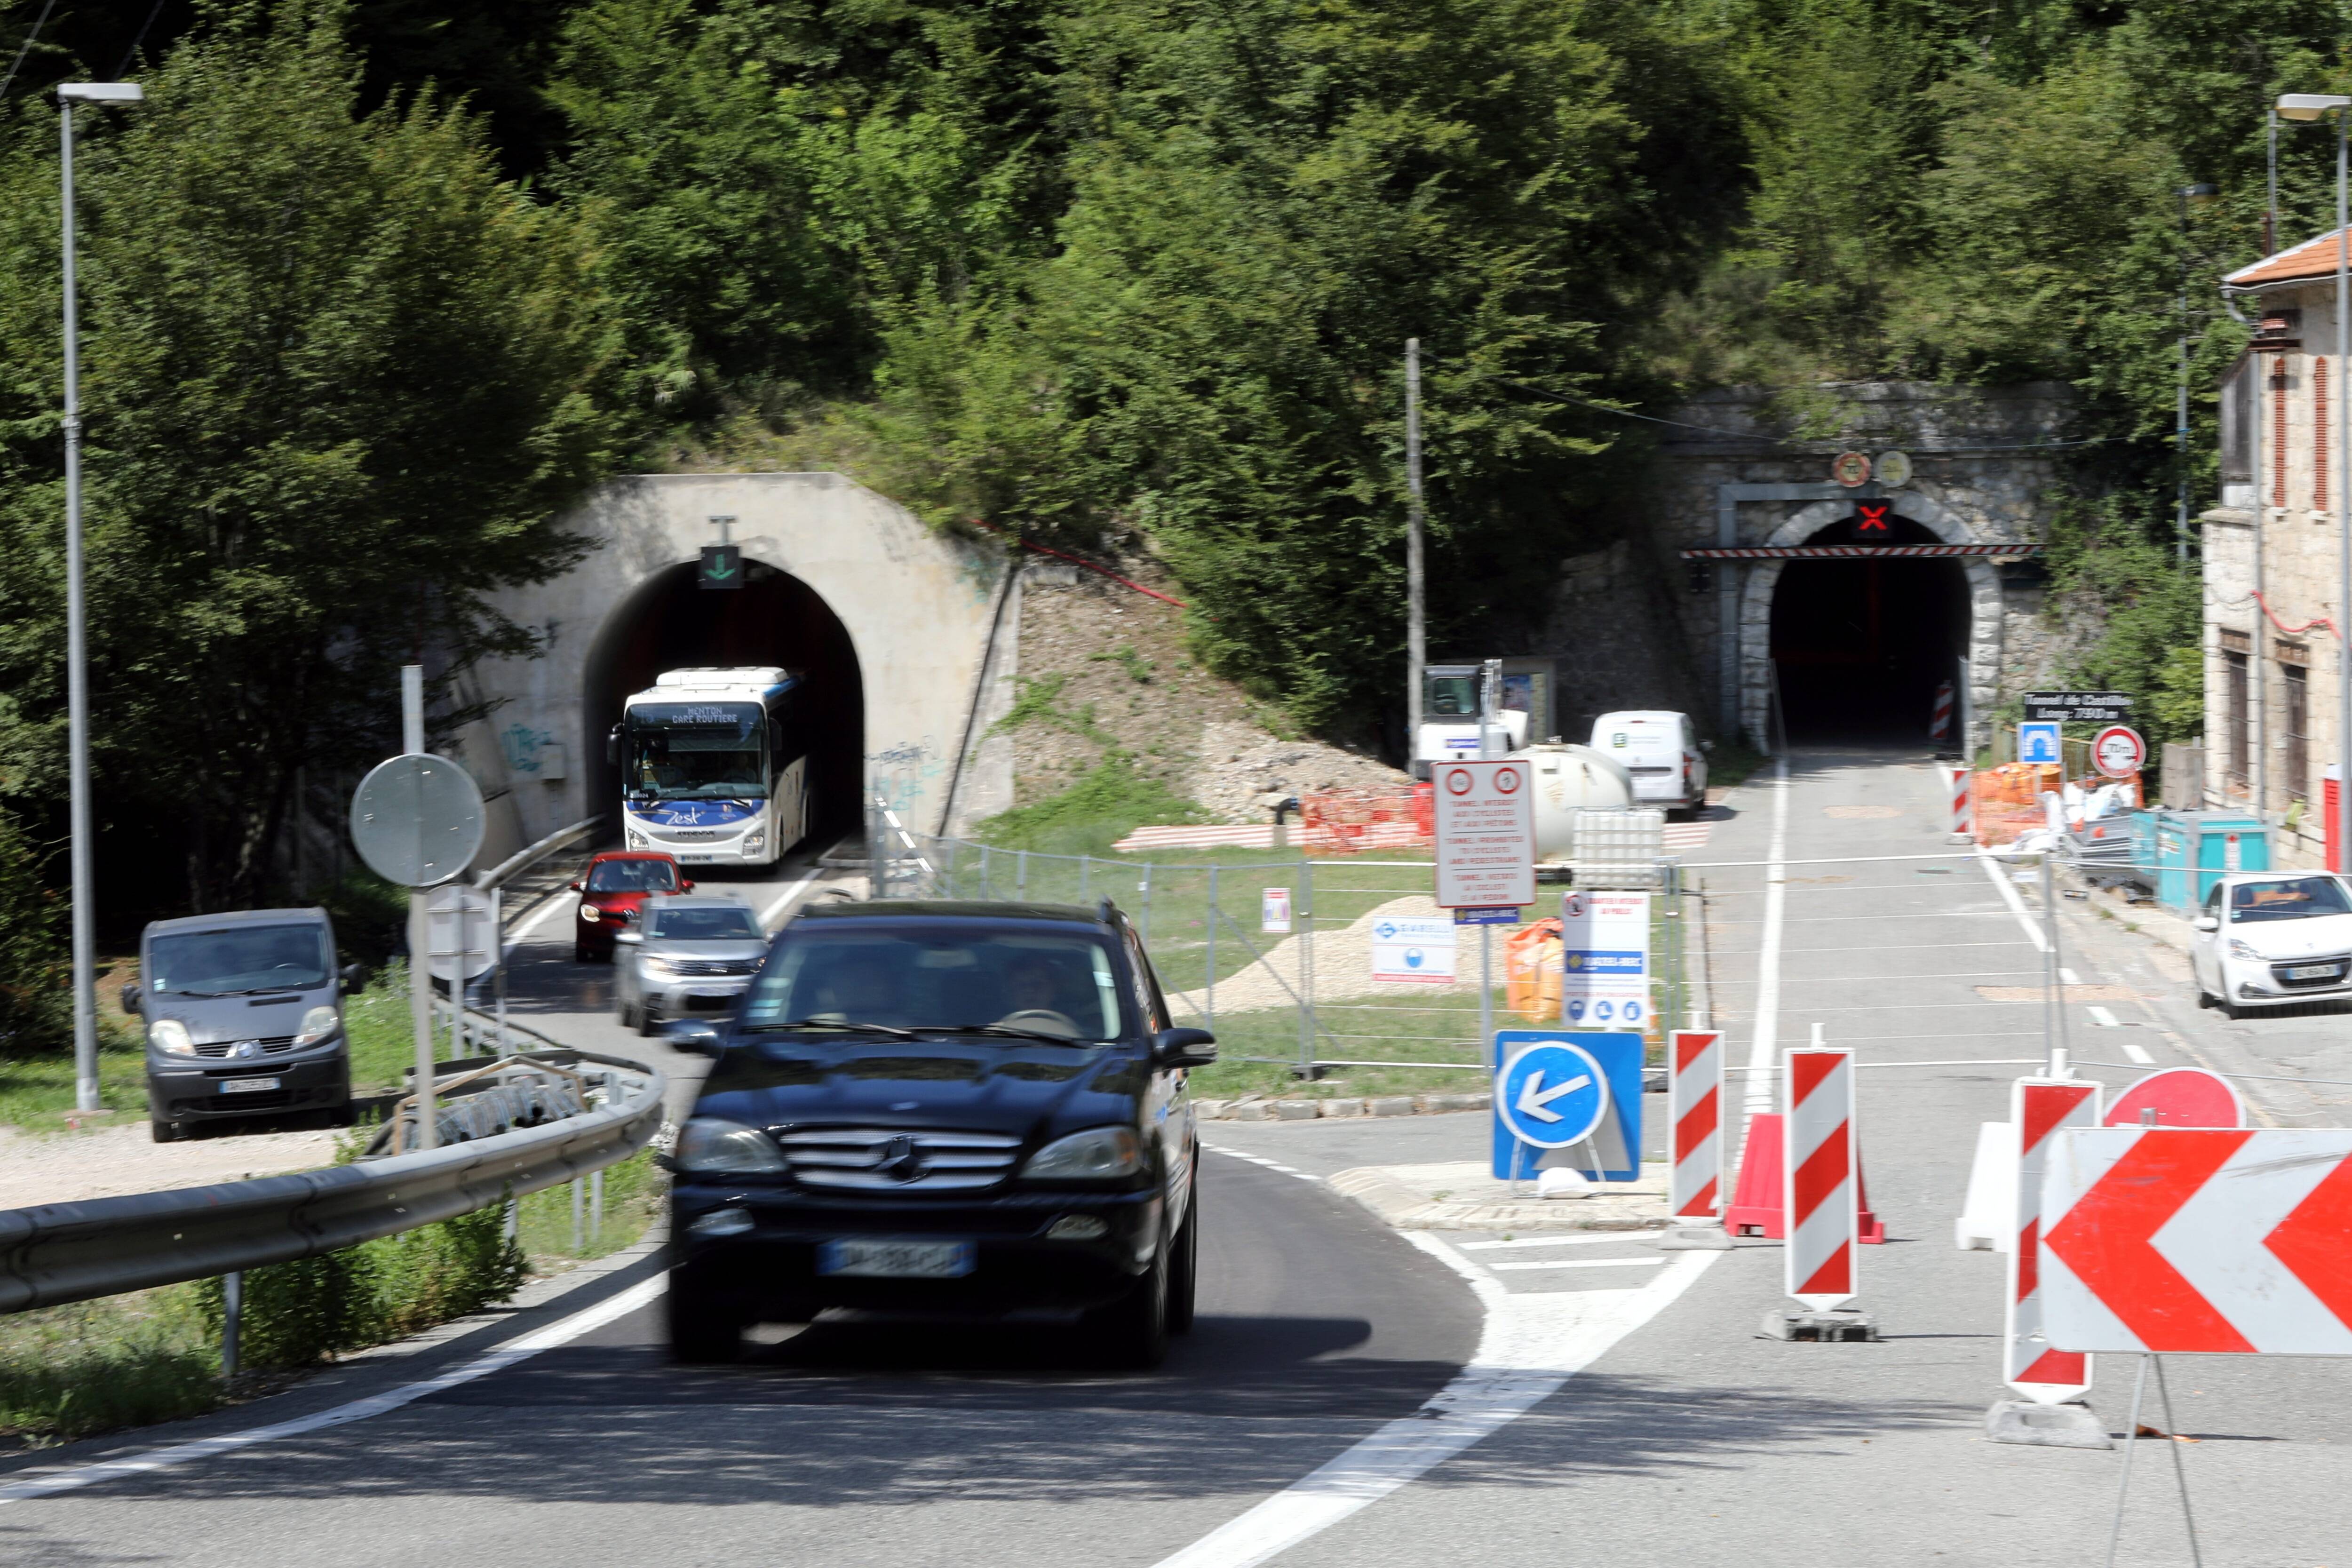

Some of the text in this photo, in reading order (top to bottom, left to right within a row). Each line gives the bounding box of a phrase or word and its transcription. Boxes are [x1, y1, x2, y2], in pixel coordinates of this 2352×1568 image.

[2024, 694, 2064, 705] Tunnel
[2064, 695, 2081, 705] de
[672, 714, 738, 723] GARE ROUTIERE
